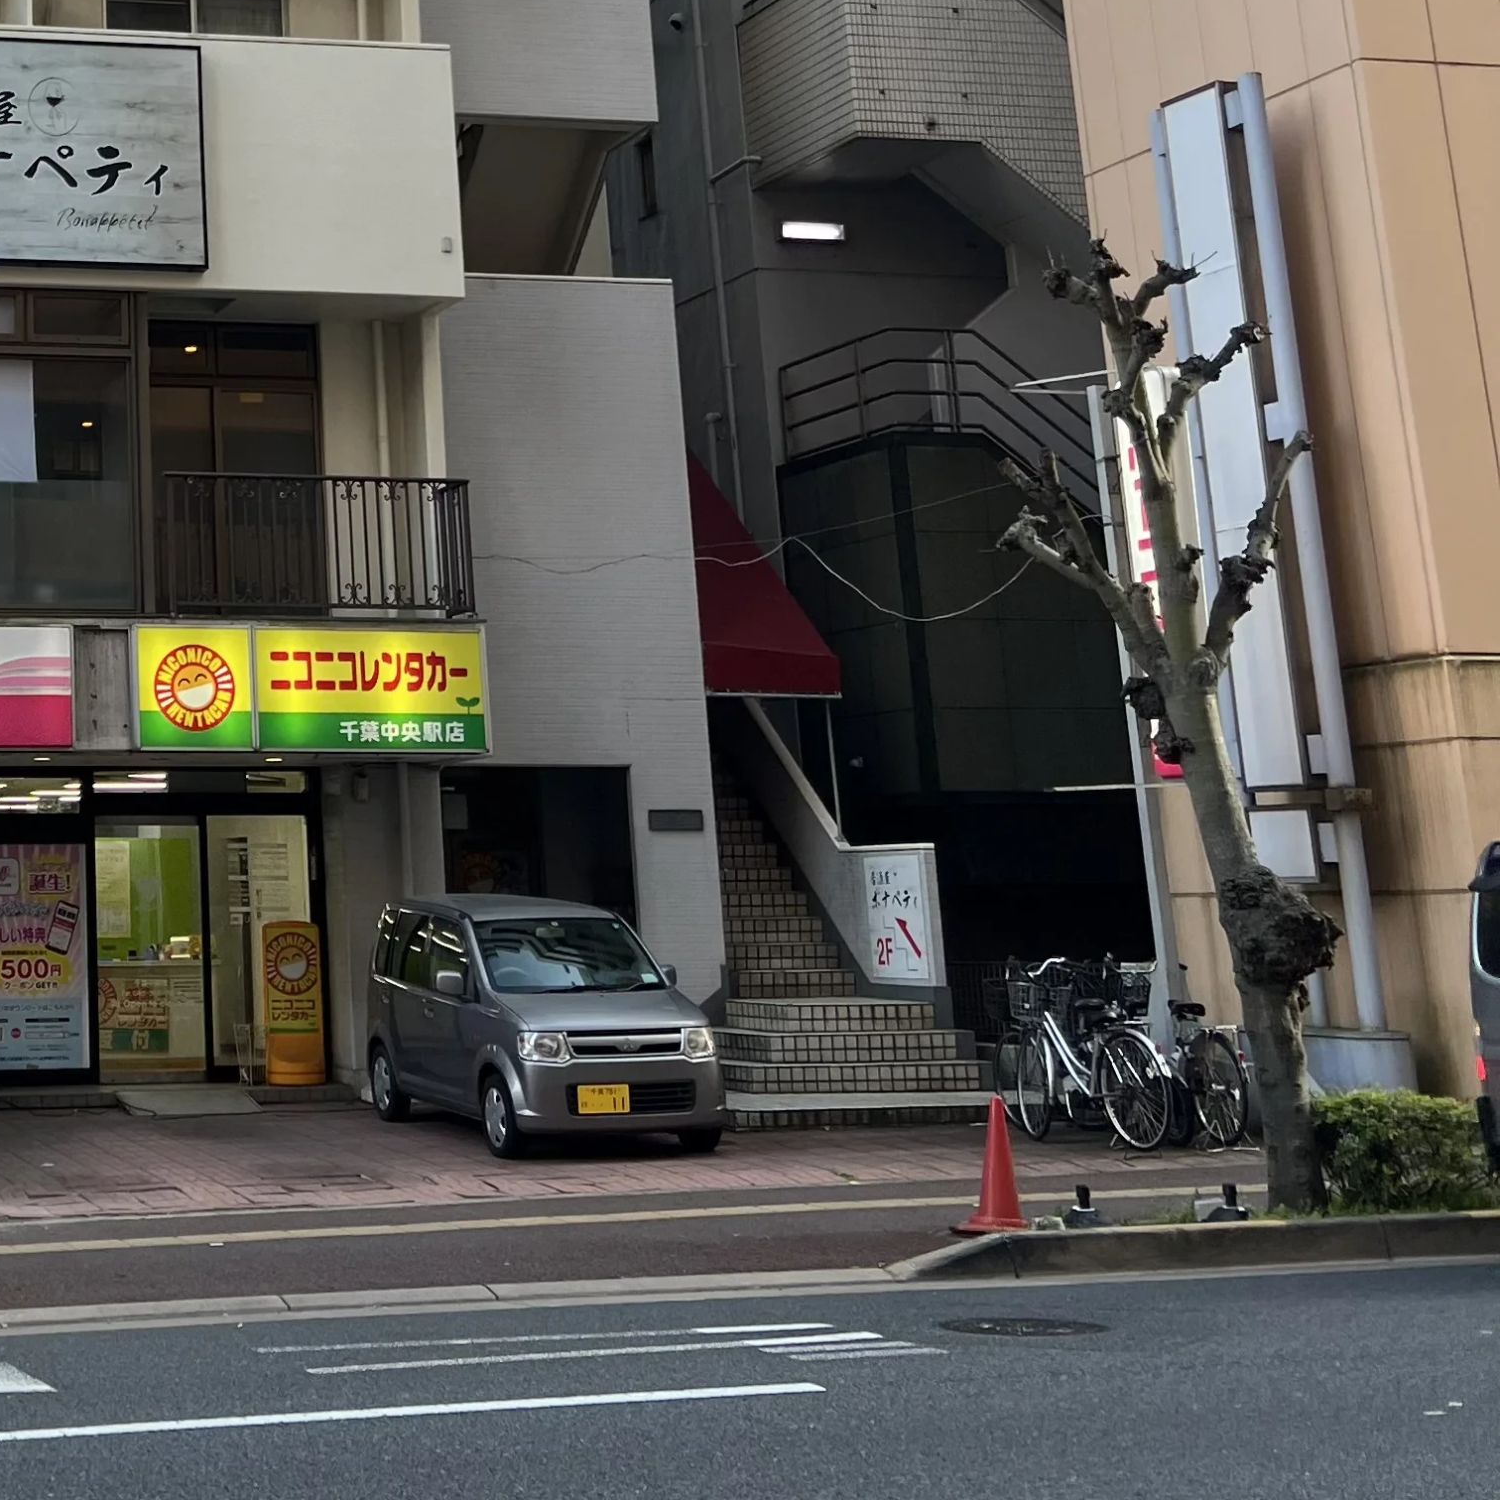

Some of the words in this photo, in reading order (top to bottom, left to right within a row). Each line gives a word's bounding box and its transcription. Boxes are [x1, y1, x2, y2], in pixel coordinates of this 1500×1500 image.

[270, 651, 468, 692] ニコニコレンタカー
[339, 720, 465, 743] 千葉中央駅店
[877, 938, 893, 965] 2F
